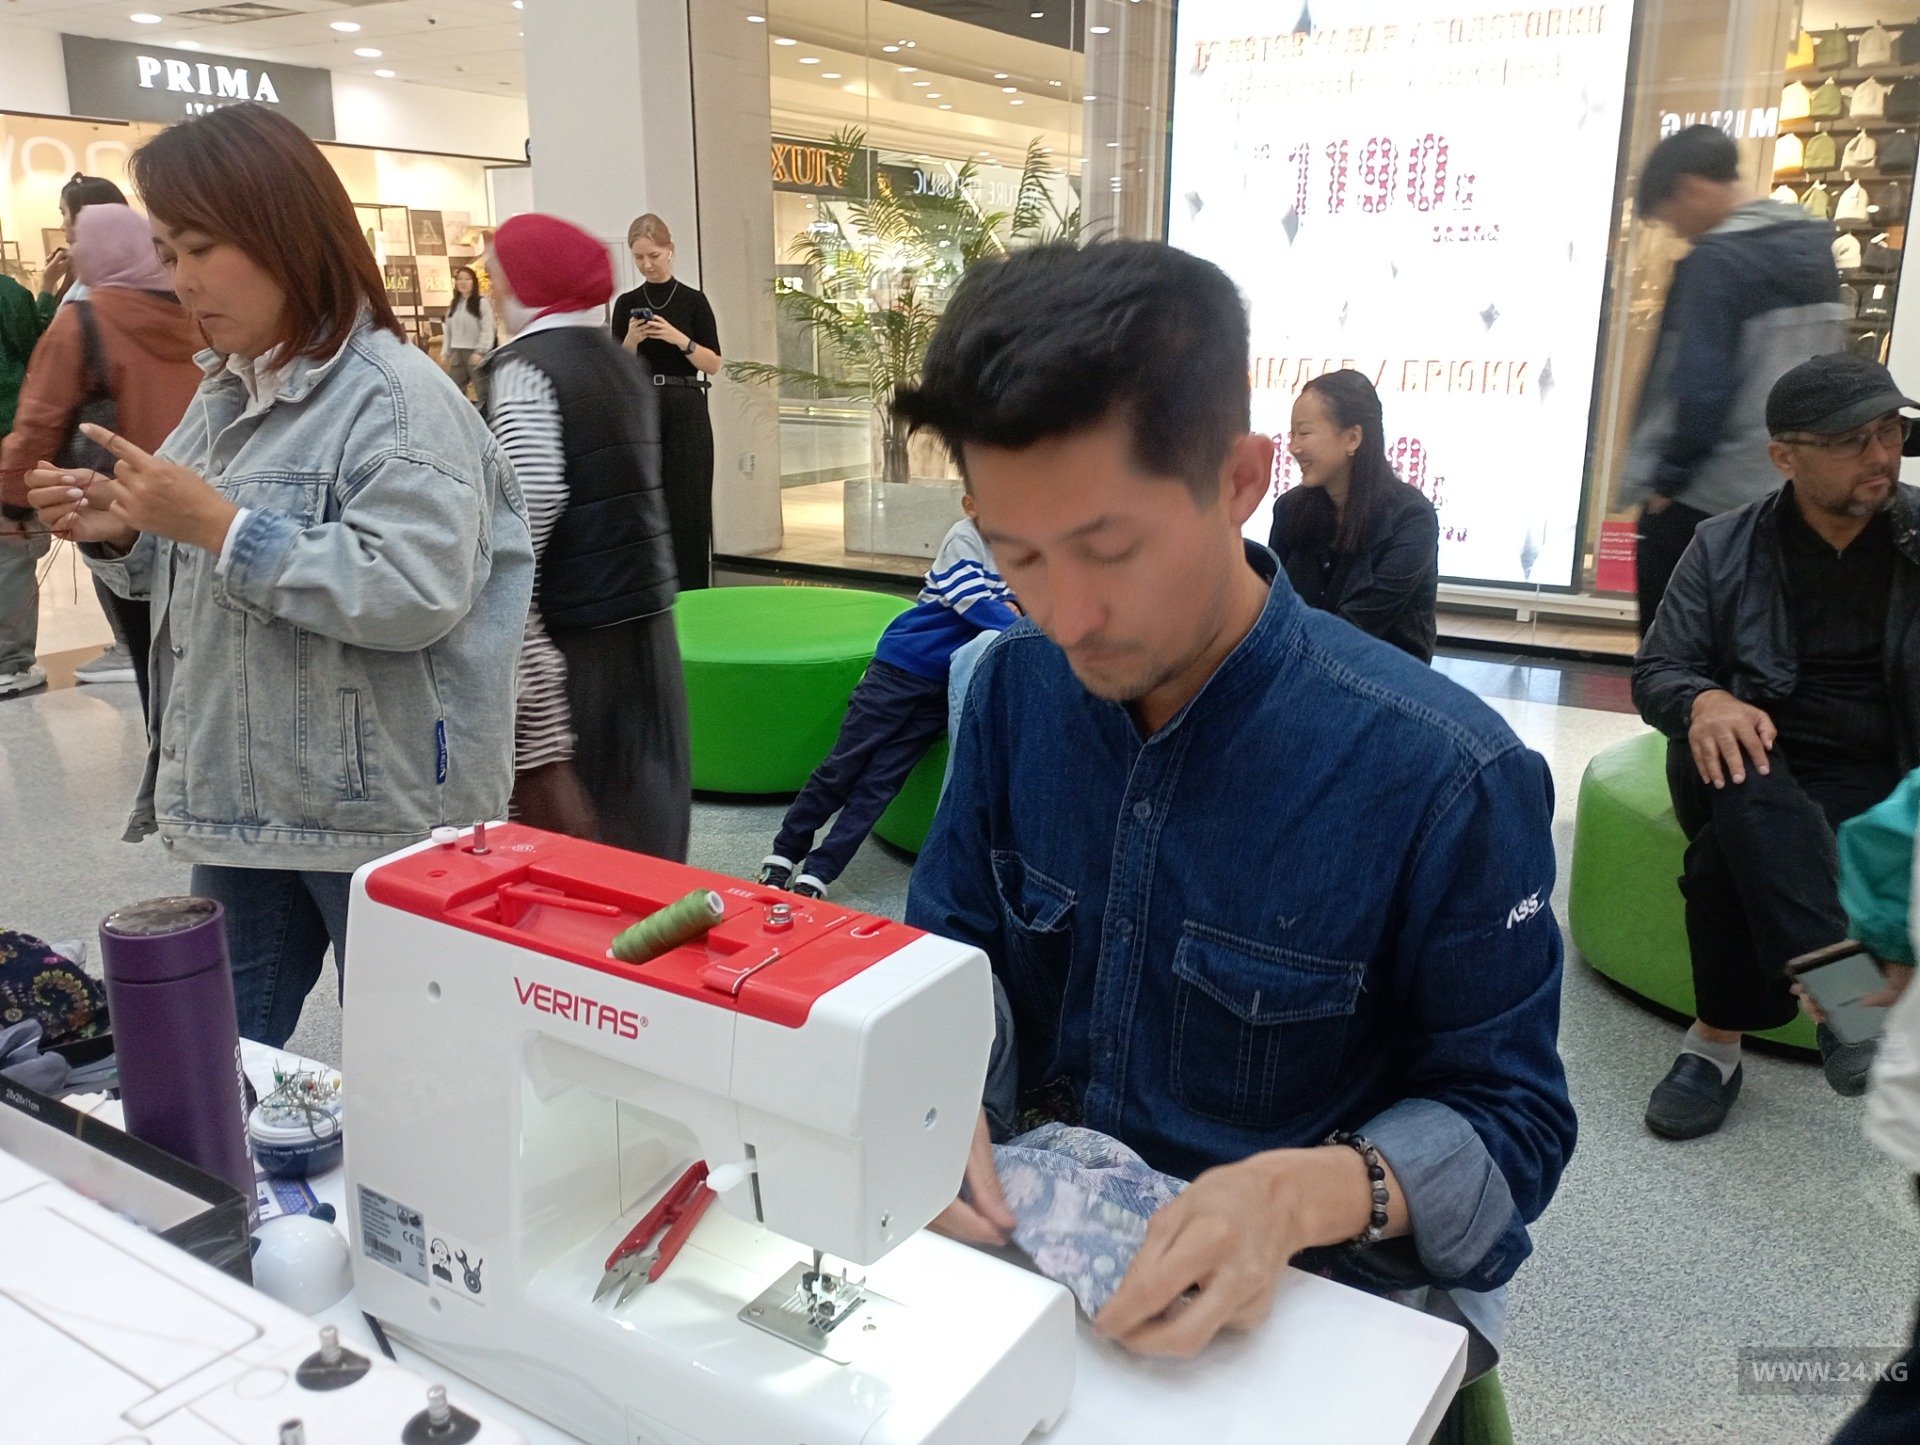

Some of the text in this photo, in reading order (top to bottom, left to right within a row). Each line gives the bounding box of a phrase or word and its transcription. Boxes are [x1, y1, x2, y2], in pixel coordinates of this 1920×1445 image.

[136, 55, 280, 103] PRIMA
[1401, 359, 1528, 395] БРЮКИ
[513, 976, 639, 1040] VERITAS
